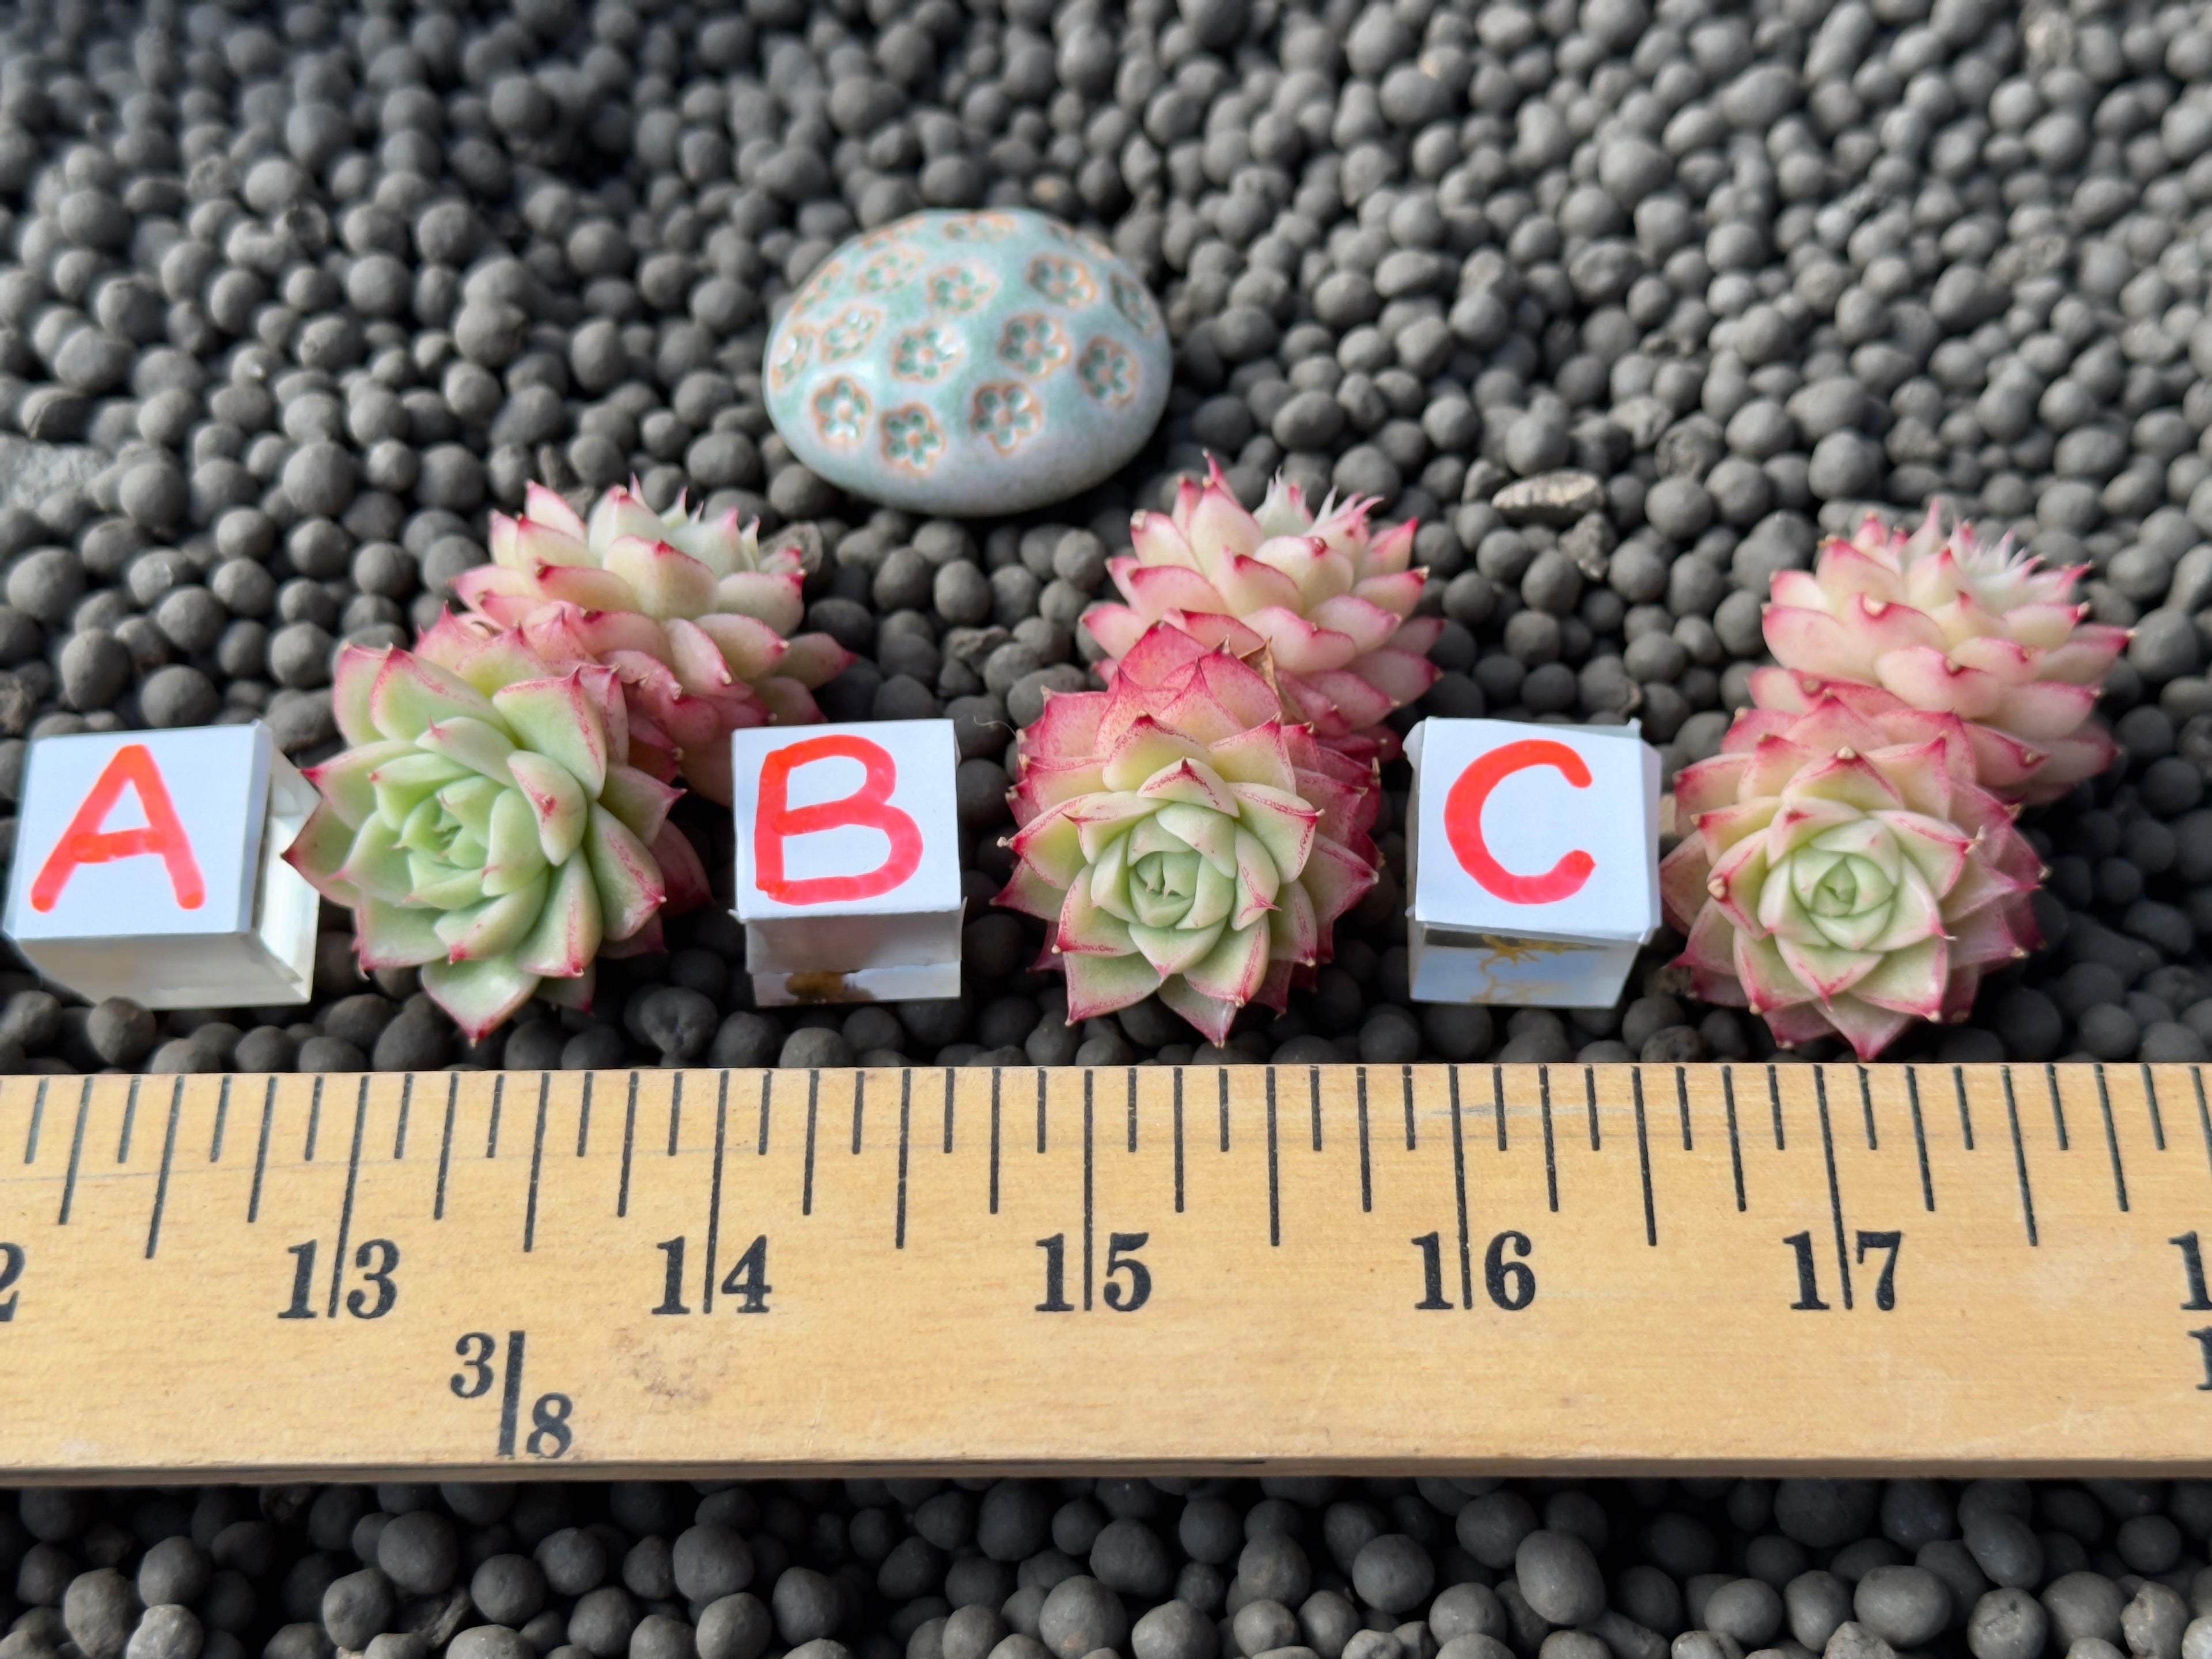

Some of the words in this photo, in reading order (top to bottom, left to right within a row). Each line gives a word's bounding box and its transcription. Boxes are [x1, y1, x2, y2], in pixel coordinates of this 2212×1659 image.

[29, 743, 206, 914] A
[753, 734, 924, 906] B
[1443, 738, 1597, 906] C
[276, 1238, 400, 1319] 13
[651, 1234, 772, 1315] 14
[1035, 1232, 1152, 1312] 15
[1411, 1230, 1536, 1311] 16
[1782, 1229, 1903, 1311] 17
